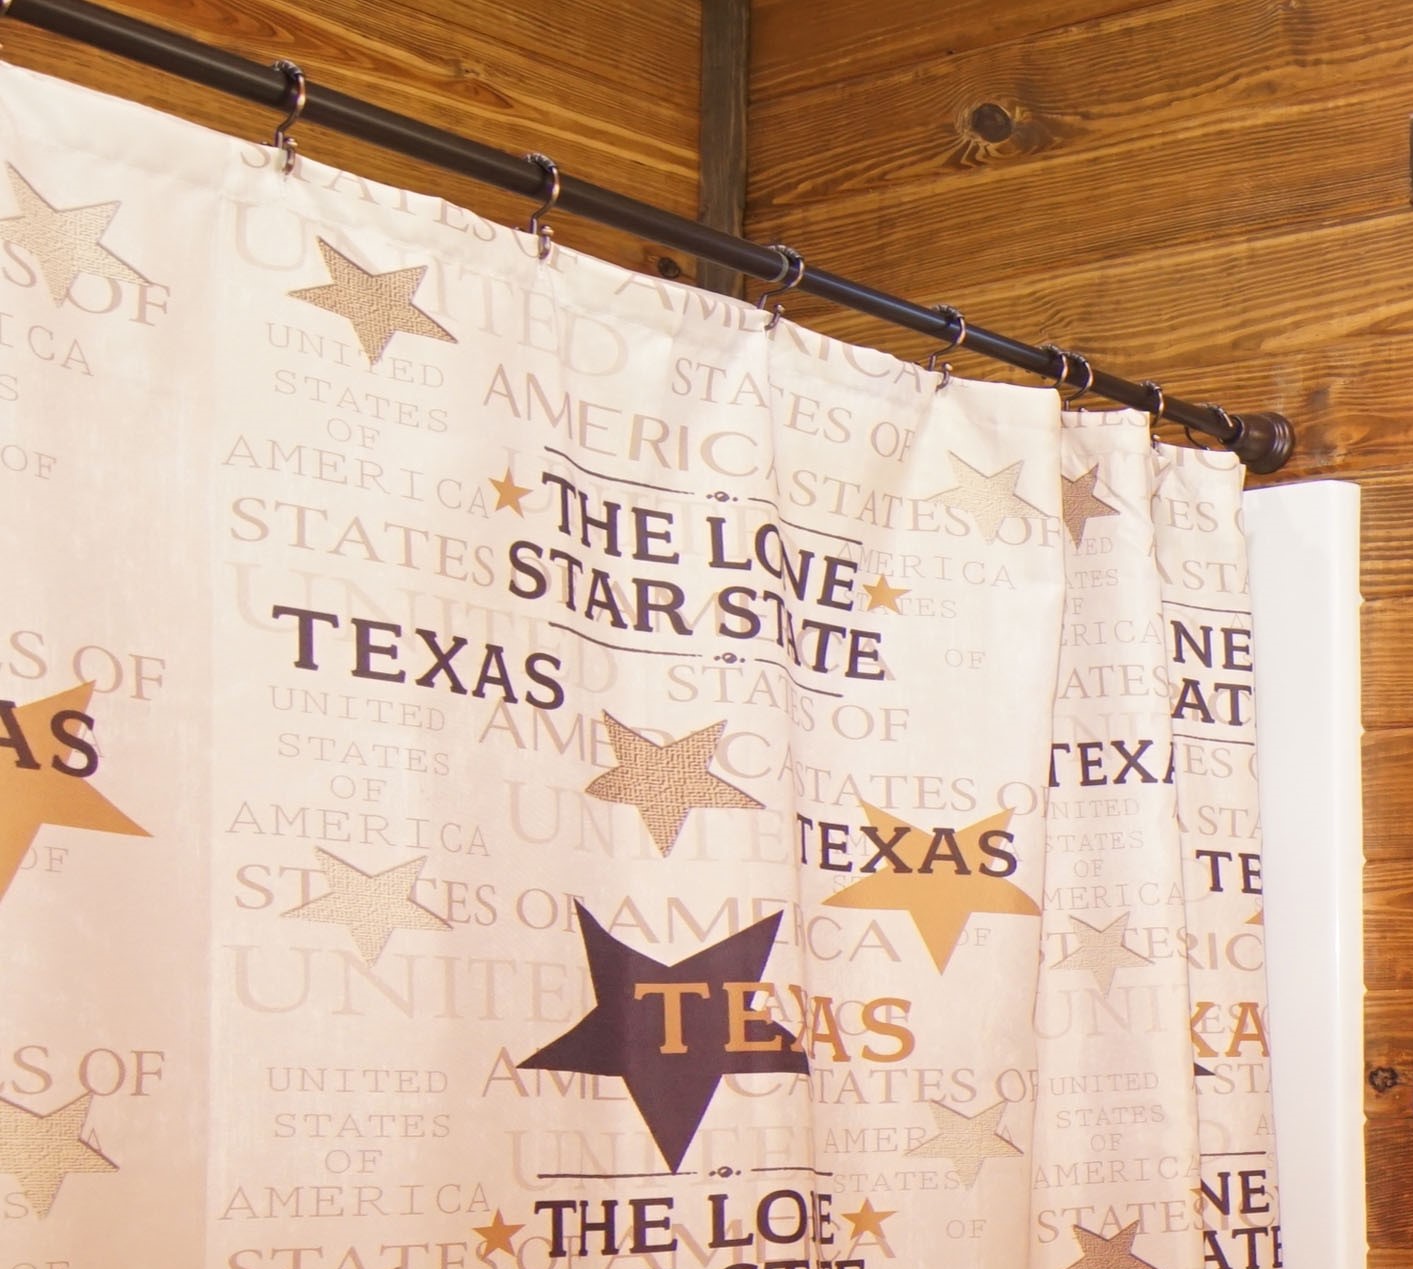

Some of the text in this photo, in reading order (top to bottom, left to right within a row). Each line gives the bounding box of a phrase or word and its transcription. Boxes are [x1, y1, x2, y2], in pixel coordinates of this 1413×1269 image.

[273, 368, 449, 433] STATES
[326, 416, 381, 450] OF
[483, 362, 782, 495] AMERIC
[222, 434, 490, 520] AMERICA
[229, 496, 496, 588] STATES
[541, 471, 680, 565] THE
[706, 516, 858, 611] LONE
[508, 540, 694, 636] STAR
[72, 645, 166, 700] OF
[272, 605, 566, 710] TEXAS
[944, 647, 986, 671] OF
[1057, 662, 1174, 700] ATES
[268, 685, 446, 733] UNITED
[832, 703, 910, 742] OF
[277, 732, 451, 777] STATES
[329, 775, 388, 803] OF
[225, 800, 491, 858] AMERICA
[797, 811, 1018, 878] TEXAS
[1073, 858, 1105, 879] OF
[78, 1048, 166, 1098] OF
[266, 1066, 449, 1094] UNITED
[1049, 1071, 1160, 1097] UNITED
[274, 1112, 451, 1139] STATES
[1056, 1104, 1166, 1129] STATES
[324, 1149, 383, 1175] OF
[1089, 1132, 1124, 1152] OF
[1033, 1155, 1202, 1190] AMERICA
[218, 1181, 492, 1221] AMERICA
[534, 1197, 679, 1259] THE
[709, 1188, 835, 1249] LOE
[945, 1218, 987, 1240] OF
